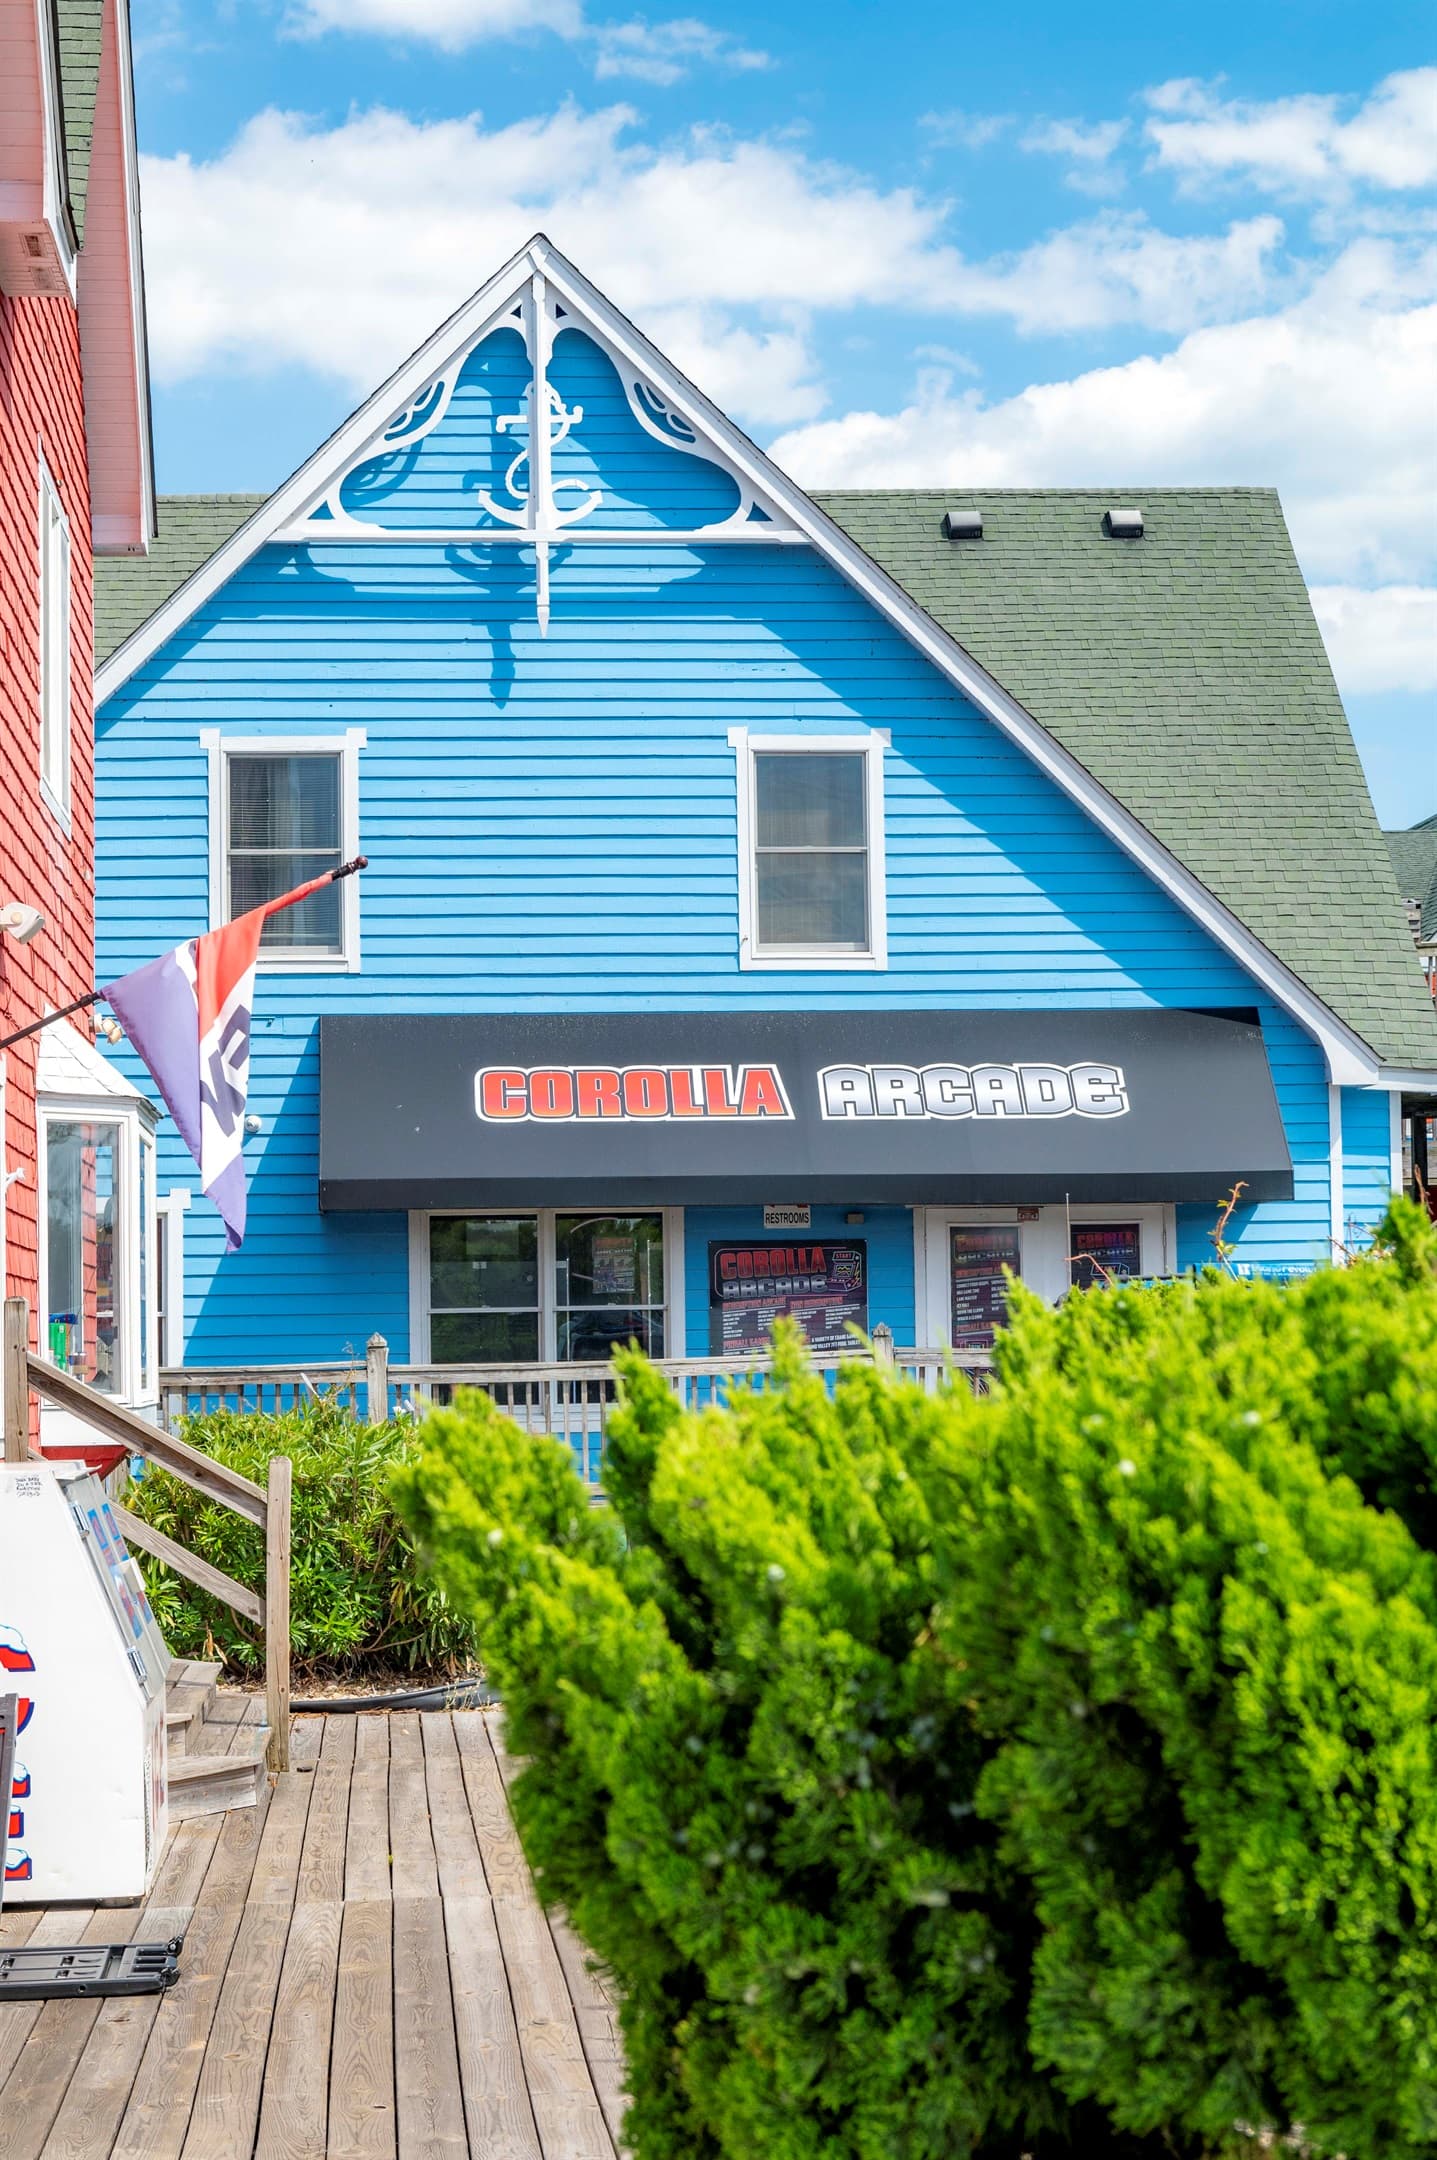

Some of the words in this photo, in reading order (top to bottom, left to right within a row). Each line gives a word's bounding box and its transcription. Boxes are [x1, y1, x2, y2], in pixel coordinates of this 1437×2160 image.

[475, 1064, 796, 1123] COROLLA
[817, 1062, 1130, 1121] ARCADE
[765, 1212, 809, 1224] RESTROOMS
[720, 1247, 827, 1280] COROLLA
[723, 1274, 829, 1299] ARCADE
